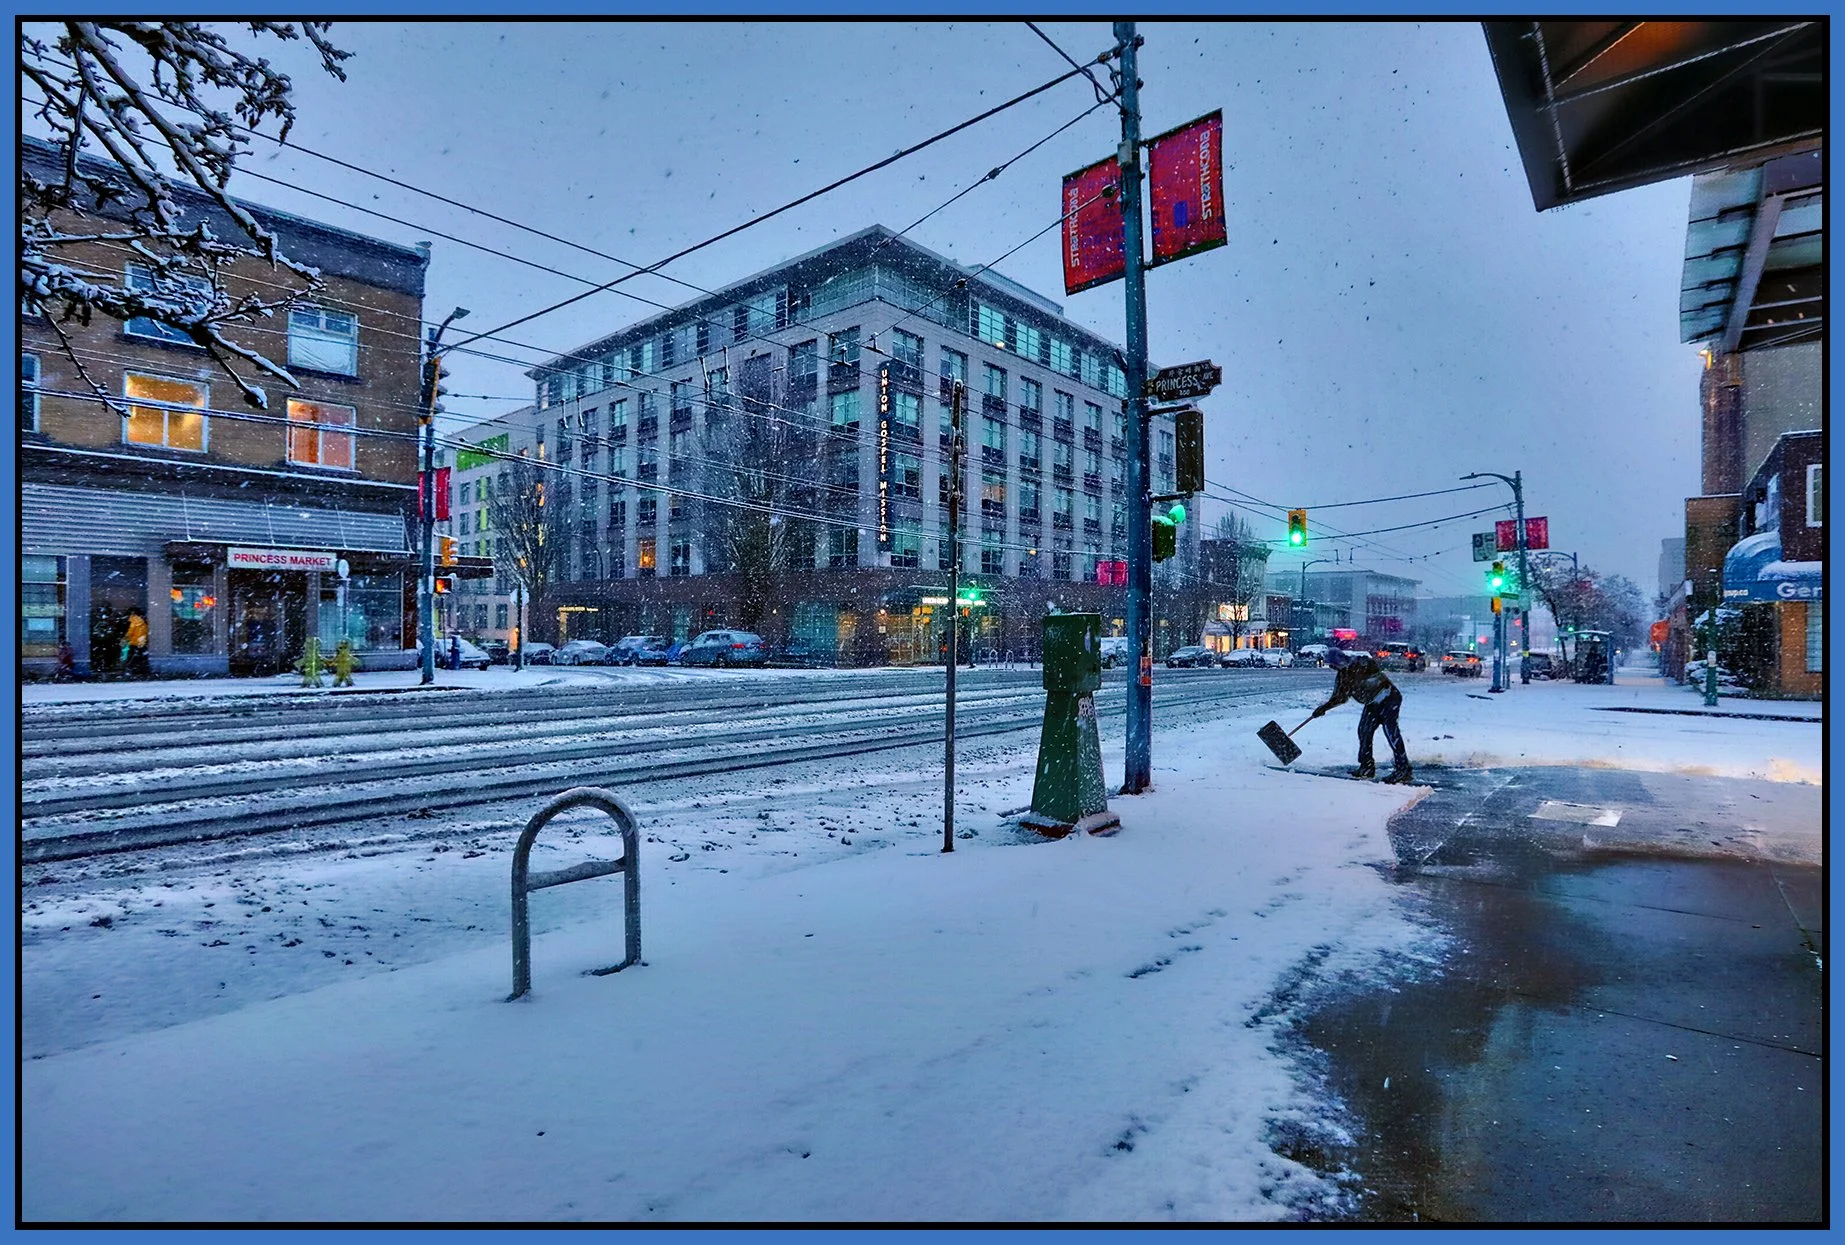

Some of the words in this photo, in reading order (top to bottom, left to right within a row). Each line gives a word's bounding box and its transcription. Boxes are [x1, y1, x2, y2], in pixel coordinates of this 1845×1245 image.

[880, 369, 888, 412] UNION
[1155, 374, 1198, 393] PRINCESS
[880, 420, 888, 474] GOSPEL
[879, 481, 888, 542] MISSION
[233, 553, 287, 564] PRINCESS
[290, 556, 331, 566] MARKET
